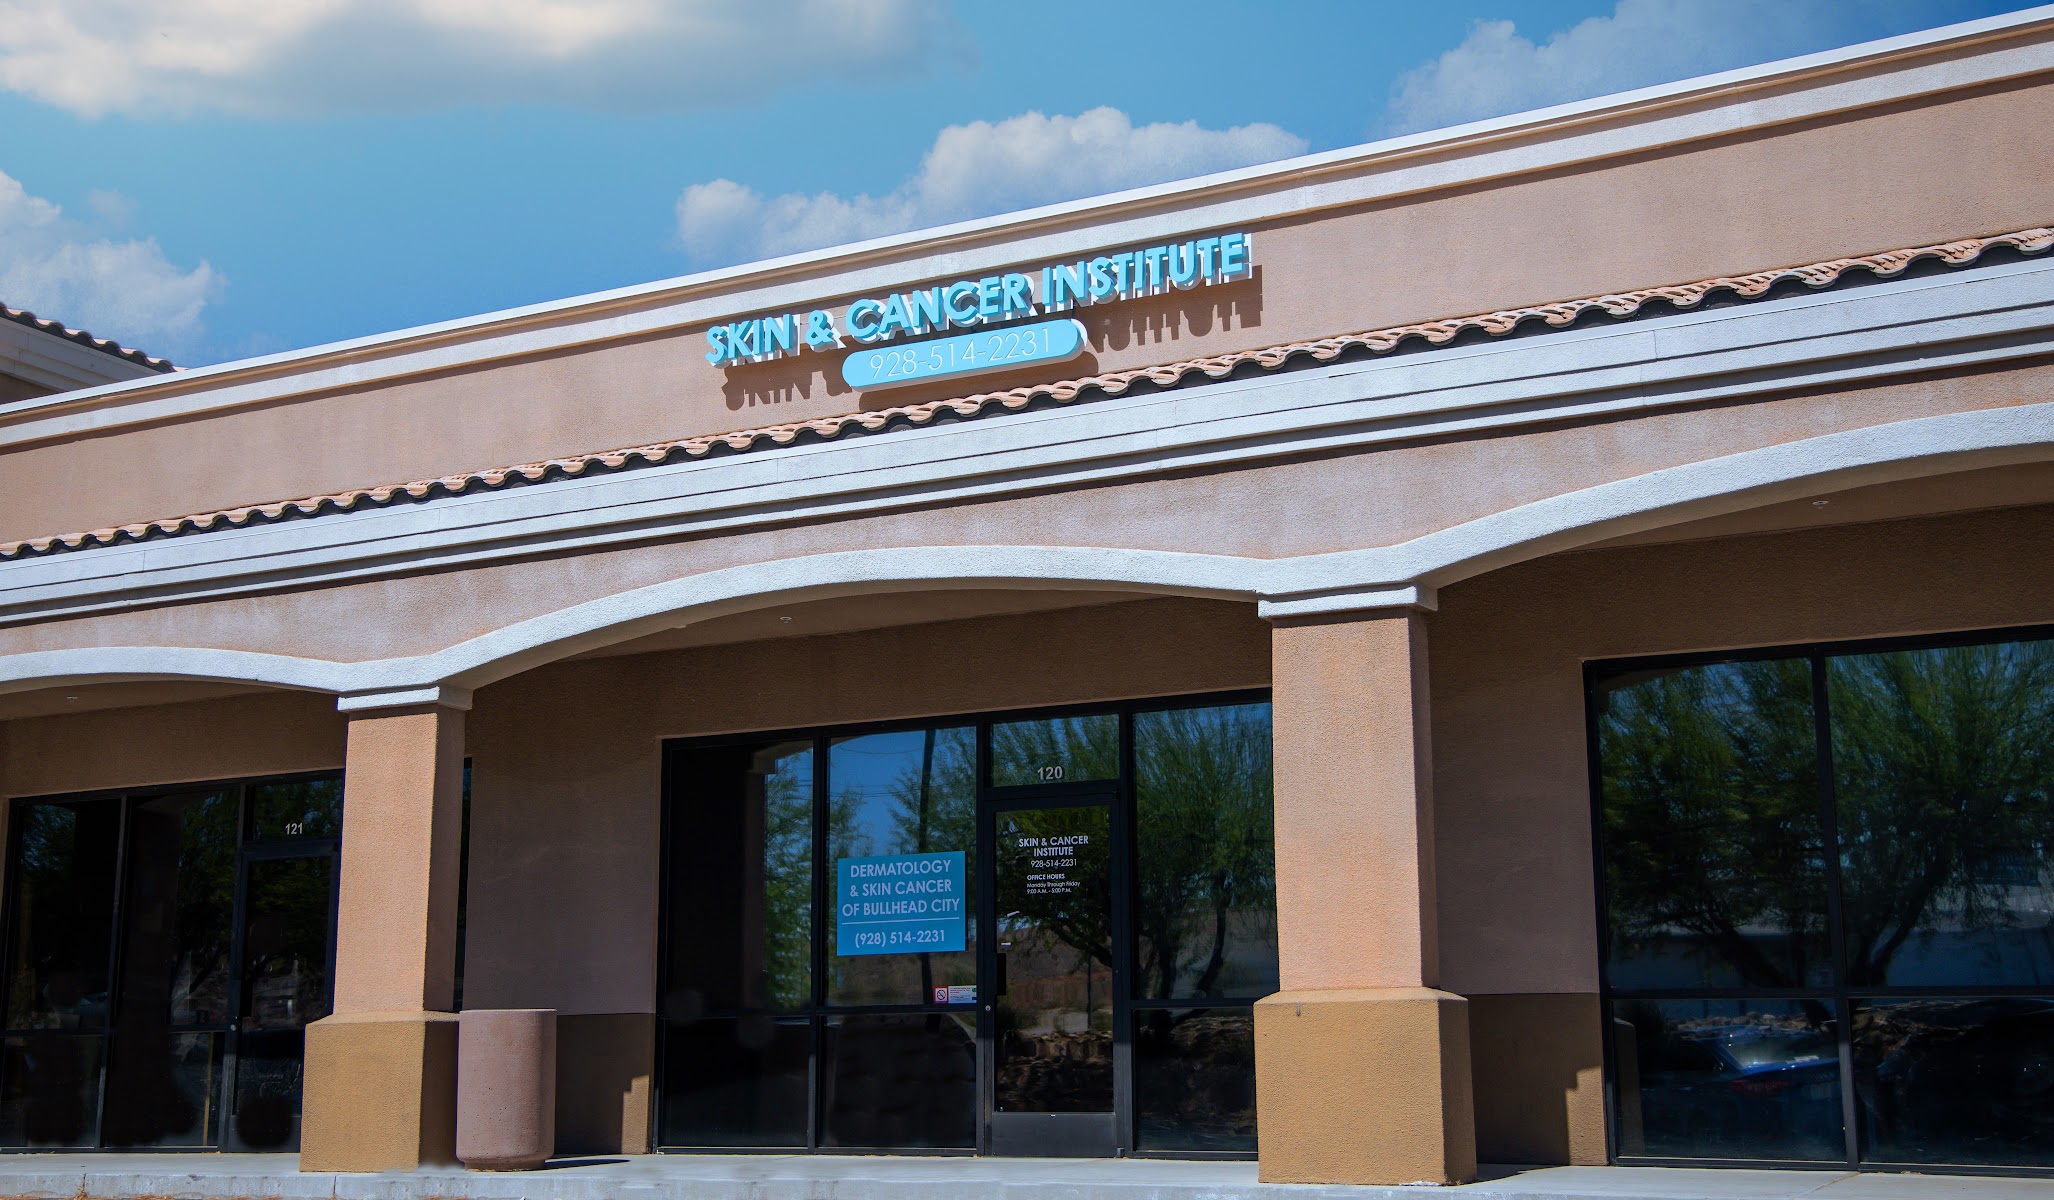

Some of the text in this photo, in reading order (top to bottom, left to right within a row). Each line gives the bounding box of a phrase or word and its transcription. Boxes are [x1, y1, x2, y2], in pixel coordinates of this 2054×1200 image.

[705, 233, 1247, 366] SKIN & CANCER INSTITUTE
[870, 328, 1049, 381] 928-514-2231
[1037, 766, 1063, 780] 120
[285, 822, 303, 835] 121
[1019, 835, 1089, 847] SKIN & CANCER
[1033, 846, 1074, 857] INSTITUTE
[850, 859, 951, 878] DERMATOLOGY
[1030, 858, 1077, 868] 928-514-2231
[849, 879, 952, 897] & SKIN CANCER
[842, 898, 960, 917] OF BULLHEAD CITY
[855, 929, 945, 949] (928) 514-2231
